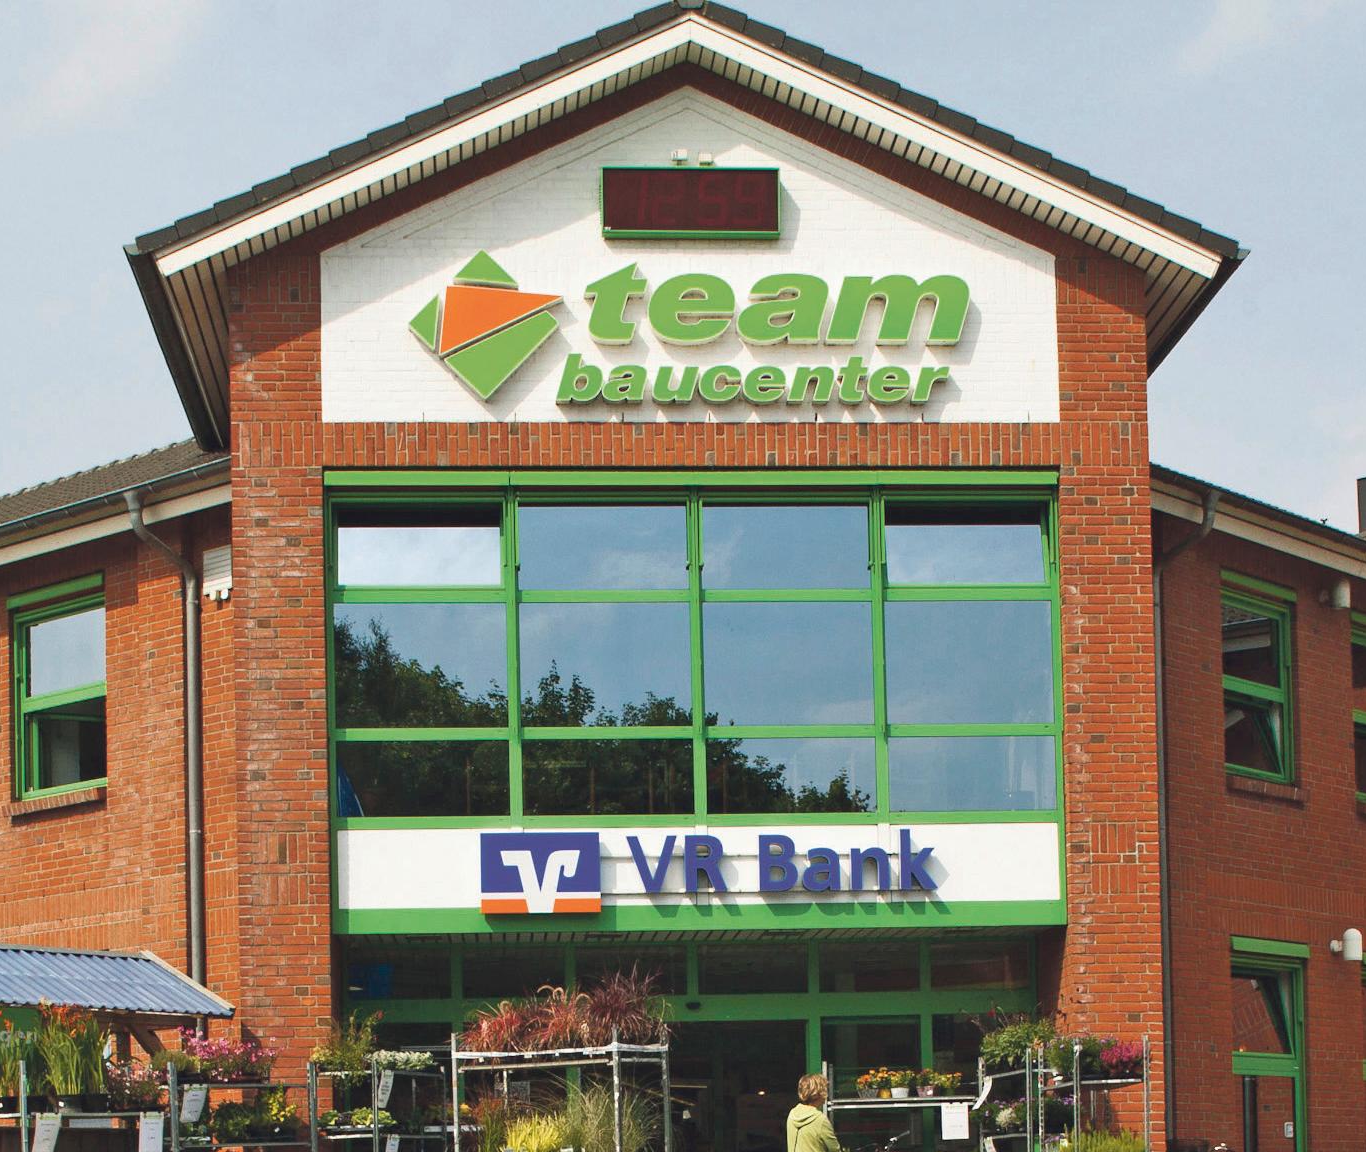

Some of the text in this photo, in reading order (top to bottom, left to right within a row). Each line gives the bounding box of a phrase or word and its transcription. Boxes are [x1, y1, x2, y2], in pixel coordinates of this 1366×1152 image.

[584, 262, 971, 346] team
[556, 353, 949, 405] baucenter
[627, 828, 939, 893] VR Bank
